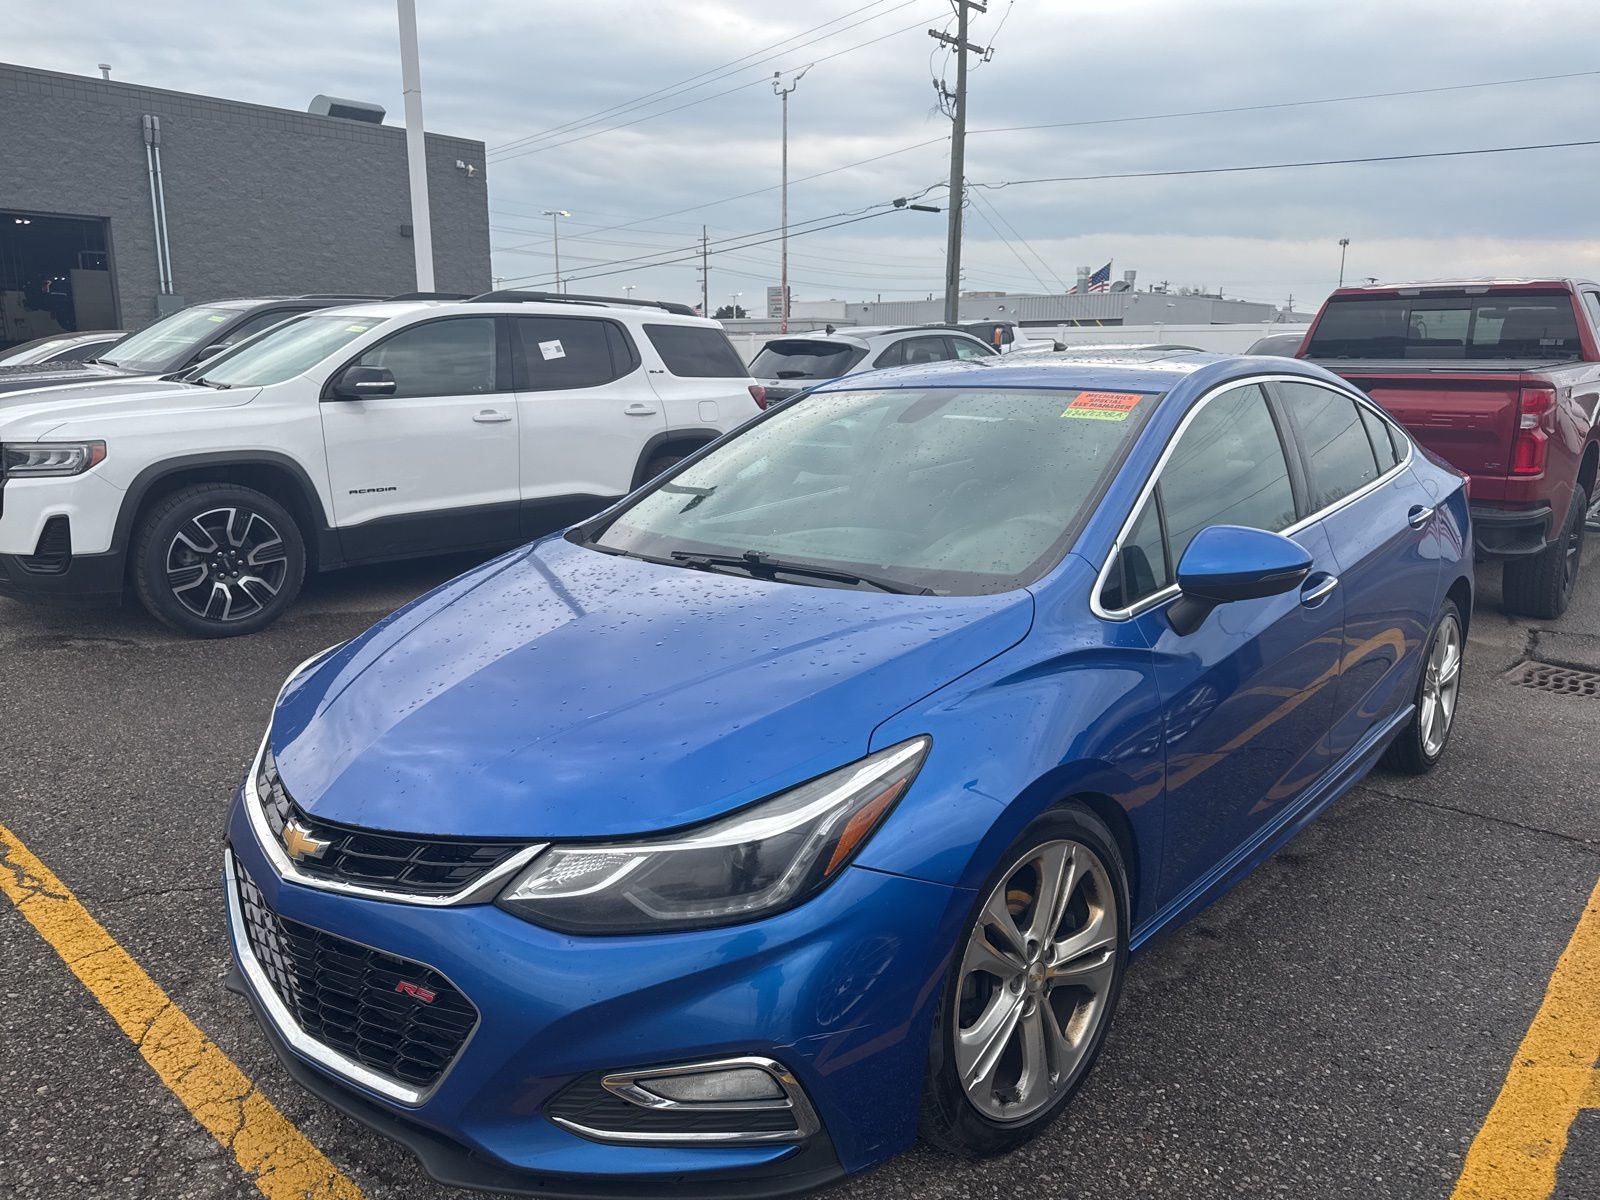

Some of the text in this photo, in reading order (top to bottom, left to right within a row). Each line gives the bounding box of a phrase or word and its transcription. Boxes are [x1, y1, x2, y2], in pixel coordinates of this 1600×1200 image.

[1086, 393, 1133, 401] MECHANICS
[349, 486, 397, 495] ACADIA
[395, 980, 437, 1003] RS
